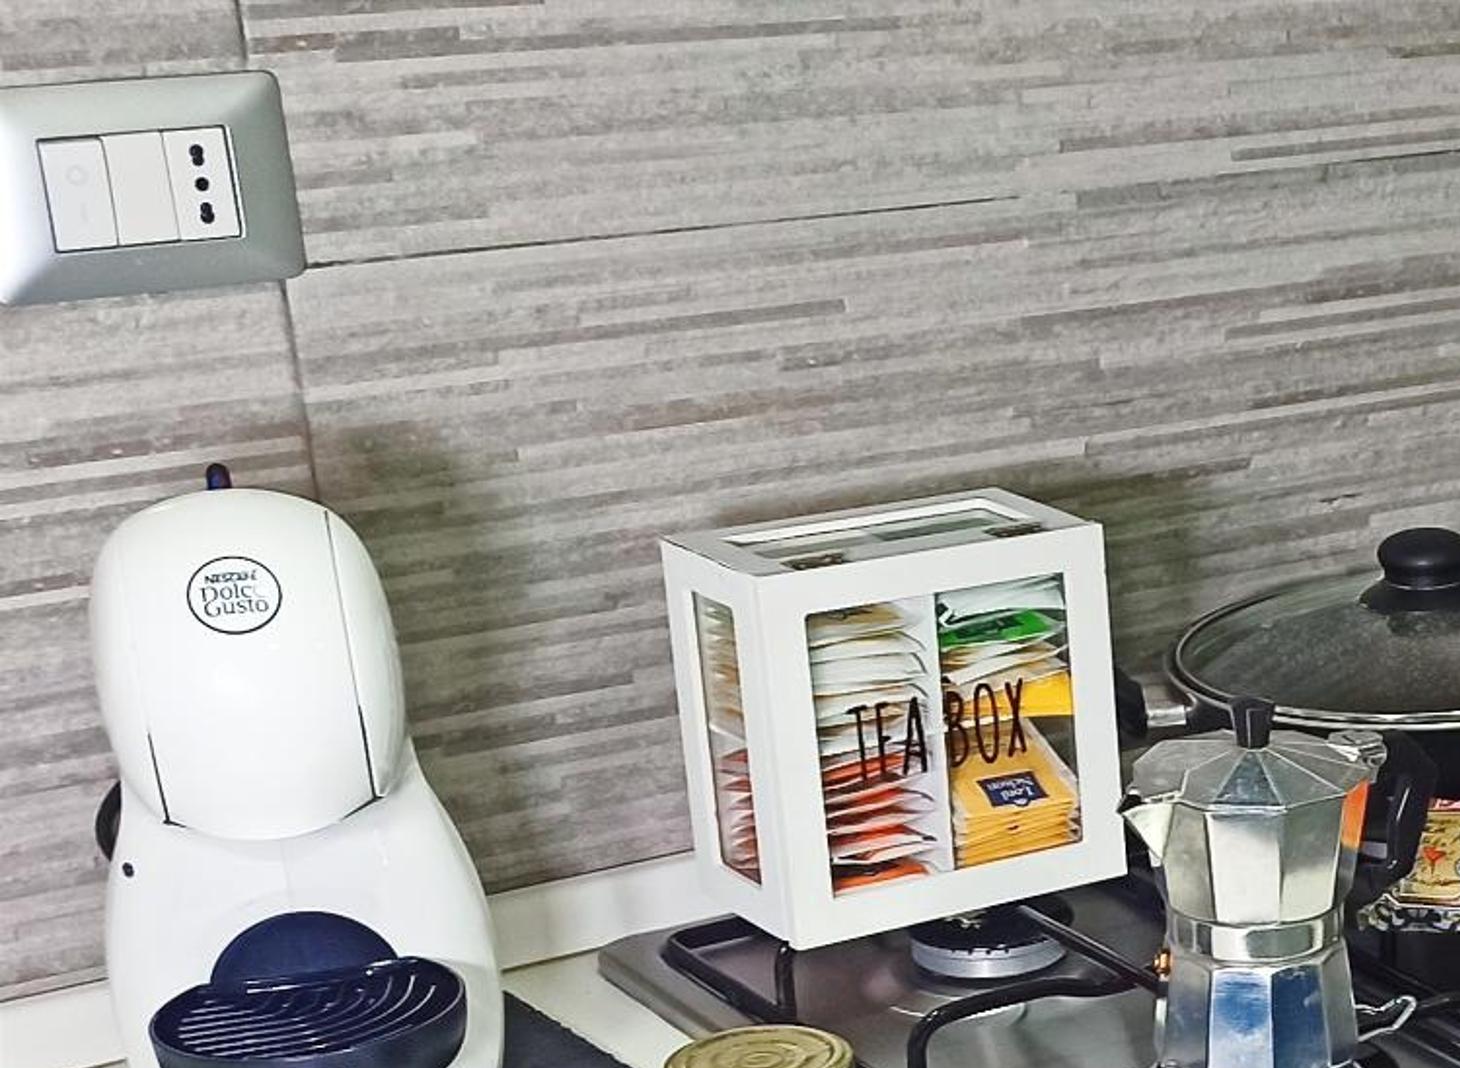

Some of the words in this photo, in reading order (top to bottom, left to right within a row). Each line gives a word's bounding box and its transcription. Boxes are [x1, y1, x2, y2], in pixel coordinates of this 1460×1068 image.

[203, 599, 270, 618] Gusto
[847, 696, 928, 783] TEA
[942, 678, 1027, 767] BOX
